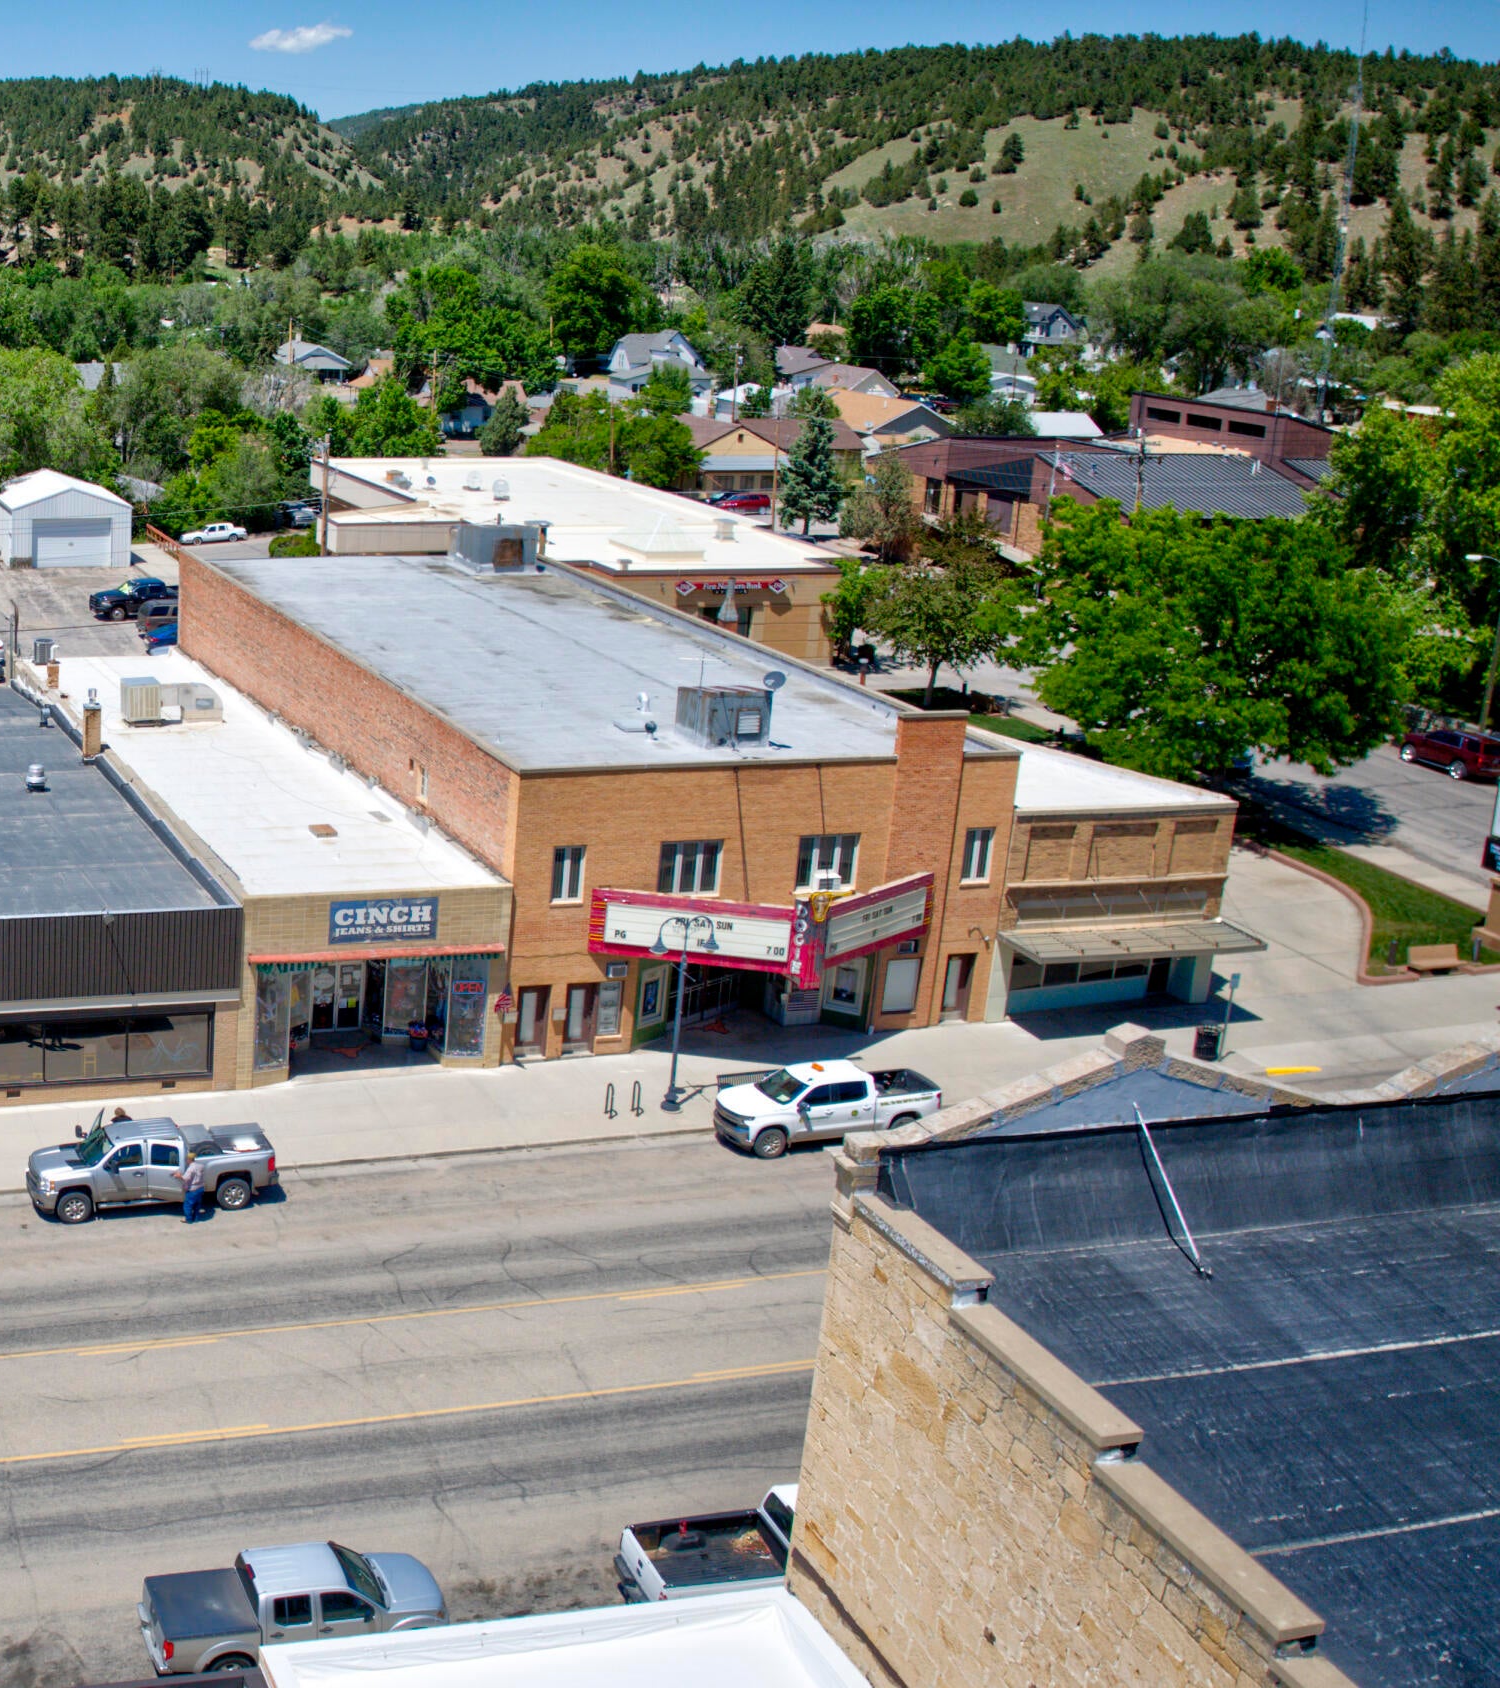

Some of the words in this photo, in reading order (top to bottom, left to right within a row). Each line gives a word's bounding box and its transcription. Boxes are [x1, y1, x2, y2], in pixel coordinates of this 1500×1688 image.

[334, 905, 432, 926] CINCH
[335, 926, 372, 937] JEANS
[374, 925, 384, 934] &
[386, 923, 431, 933] SHIRTS
[693, 918, 711, 929] SAT
[715, 920, 733, 931] SUN
[614, 929, 626, 939] PG
[453, 982, 485, 993] OPEN
